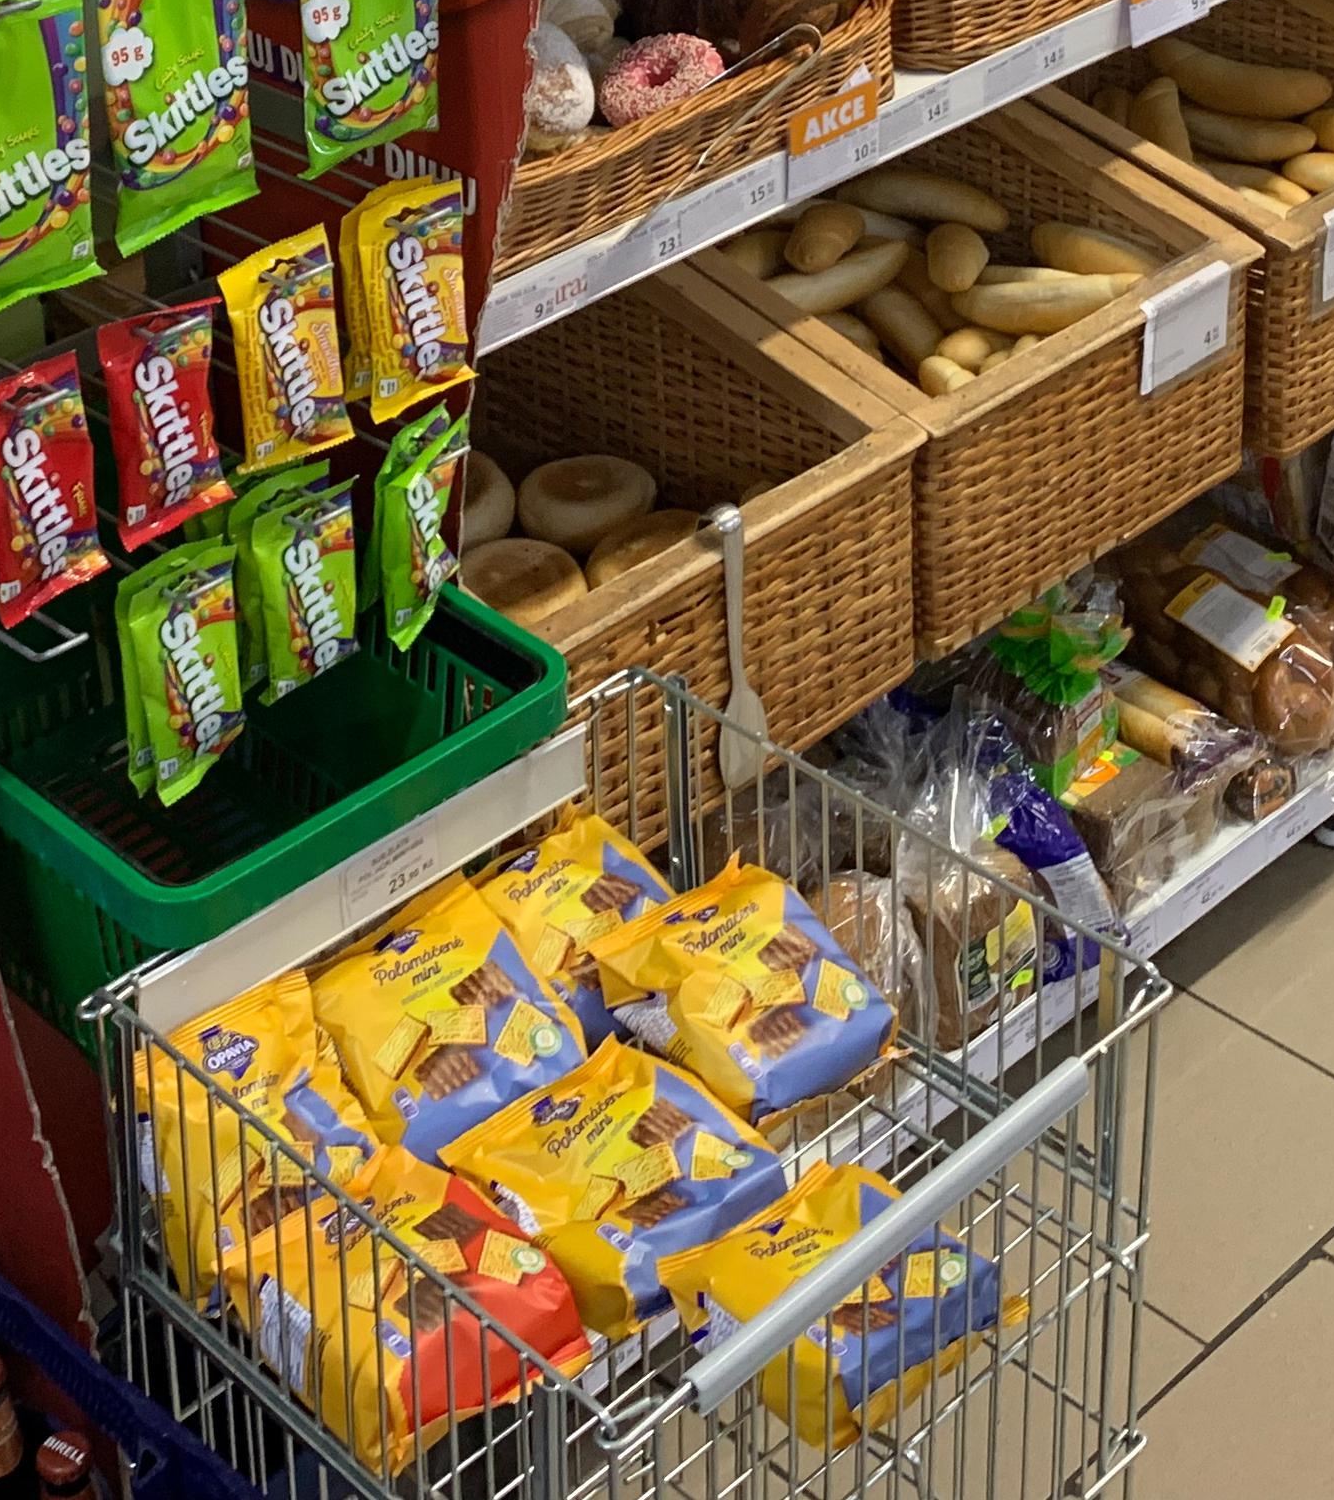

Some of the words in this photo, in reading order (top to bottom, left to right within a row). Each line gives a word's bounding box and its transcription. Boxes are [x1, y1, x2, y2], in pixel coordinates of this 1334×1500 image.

[322, 19, 440, 119] Skittles
[1043, 51, 1057, 70] 14
[123, 54, 249, 166] Skittles
[802, 94, 867, 145] AKCE
[926, 104, 941, 122] 14
[853, 145, 869, 163] 10
[749, 187, 766, 205] 15
[658, 237, 676, 258] 23
[388, 235, 447, 380] Skittle
[260, 297, 319, 440] Skittle
[134, 354, 200, 506] Skittles
[2, 427, 73, 581] Skittles
[544, 872, 570, 899] mini
[717, 927, 748, 957] mini
[372, 935, 465, 988] Polomáčené
[410, 960, 443, 988] mini
[206, 1036, 259, 1073] OPAVIA
[547, 1088, 627, 1160] Polomáčen
[585, 1113, 615, 1148] mini
[790, 1238, 822, 1258] mini
